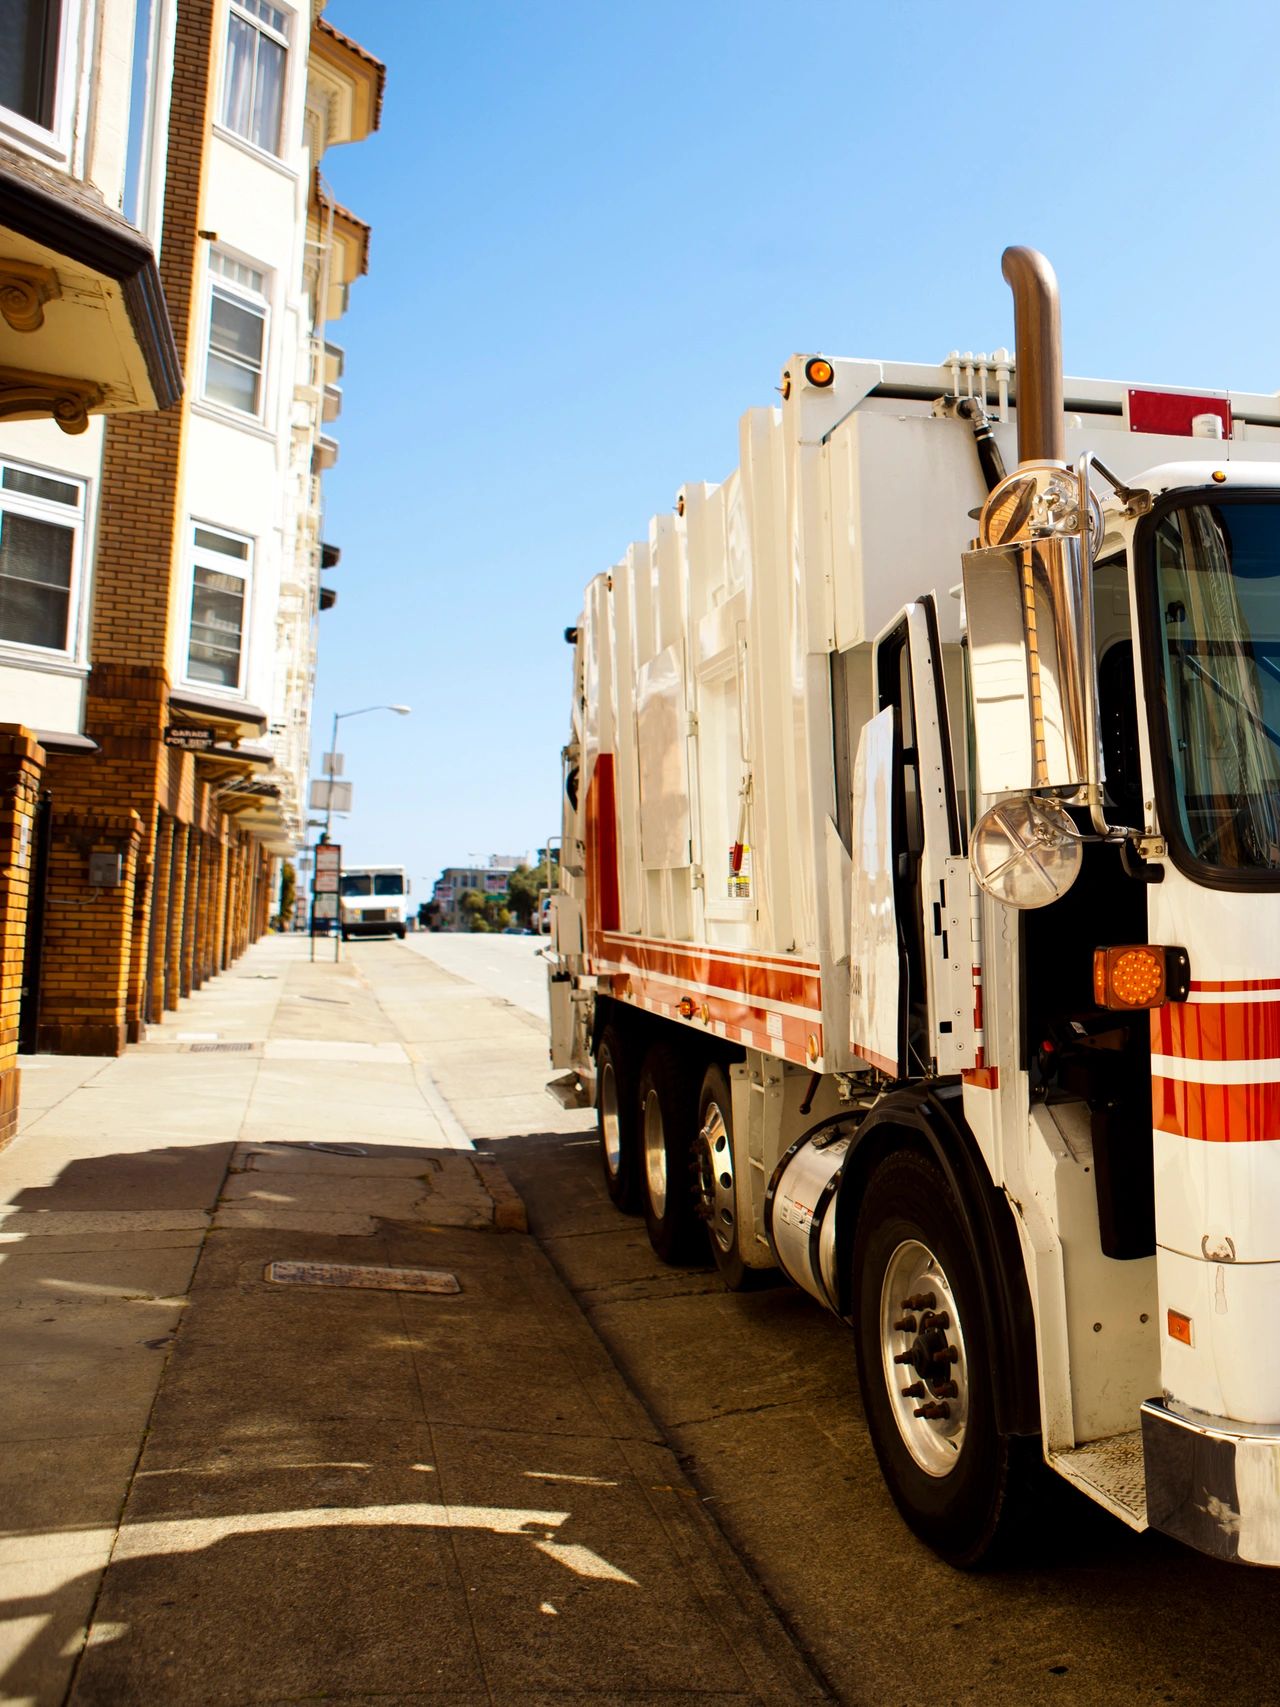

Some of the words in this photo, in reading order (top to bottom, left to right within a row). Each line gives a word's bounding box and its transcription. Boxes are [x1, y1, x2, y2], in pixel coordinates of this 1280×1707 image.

[171, 729, 209, 738] GARAGE
[166, 737, 186, 745] FOR
[188, 738, 212, 746] RENT
